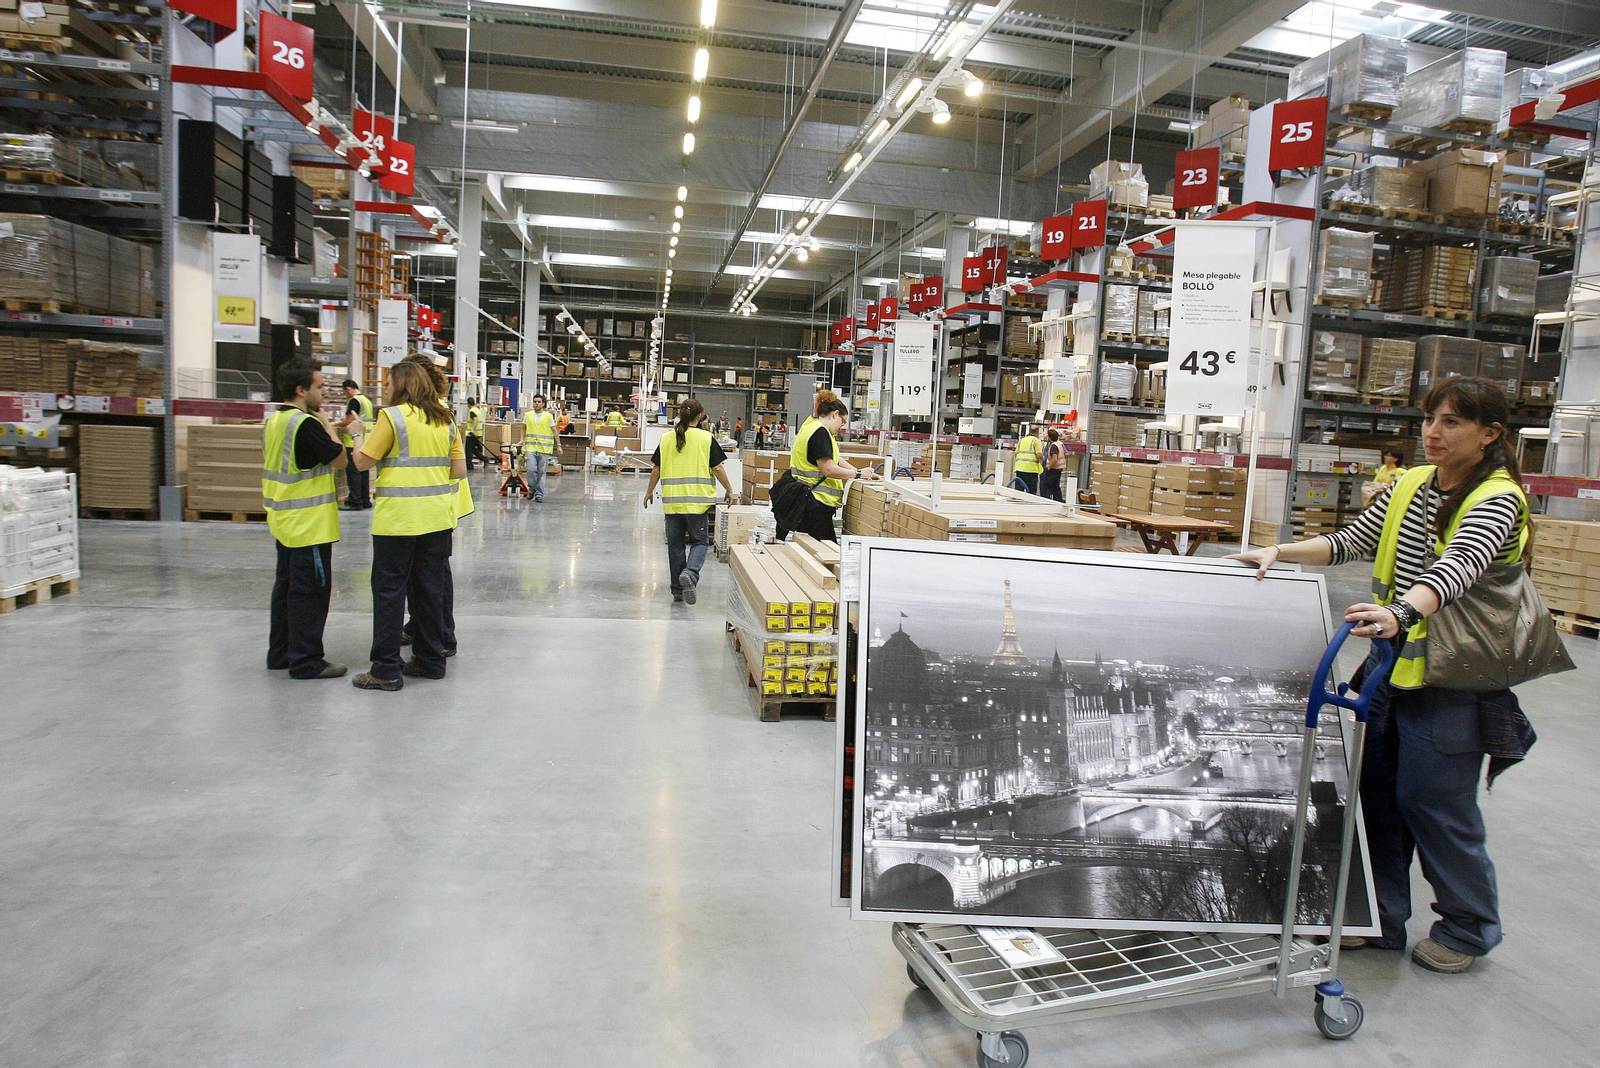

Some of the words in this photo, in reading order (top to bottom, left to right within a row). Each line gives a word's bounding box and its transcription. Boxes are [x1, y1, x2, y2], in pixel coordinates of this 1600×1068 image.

[272, 40, 305, 69] 26
[1280, 122, 1313, 144] 25
[362, 130, 386, 151] 24
[390, 156, 409, 176] 22
[1182, 168, 1208, 186] 23
[1078, 216, 1098, 230] 21
[1046, 230, 1064, 244] 19
[986, 259, 1001, 270] 17
[966, 268, 980, 278] 15
[1206, 272, 1241, 280] plegable
[926, 286, 938, 296] 13
[1182, 281, 1214, 290] BOLLÖ
[912, 293, 923, 301] 11
[1180, 351, 1220, 376] 43
[1225, 351, 1236, 363] €
